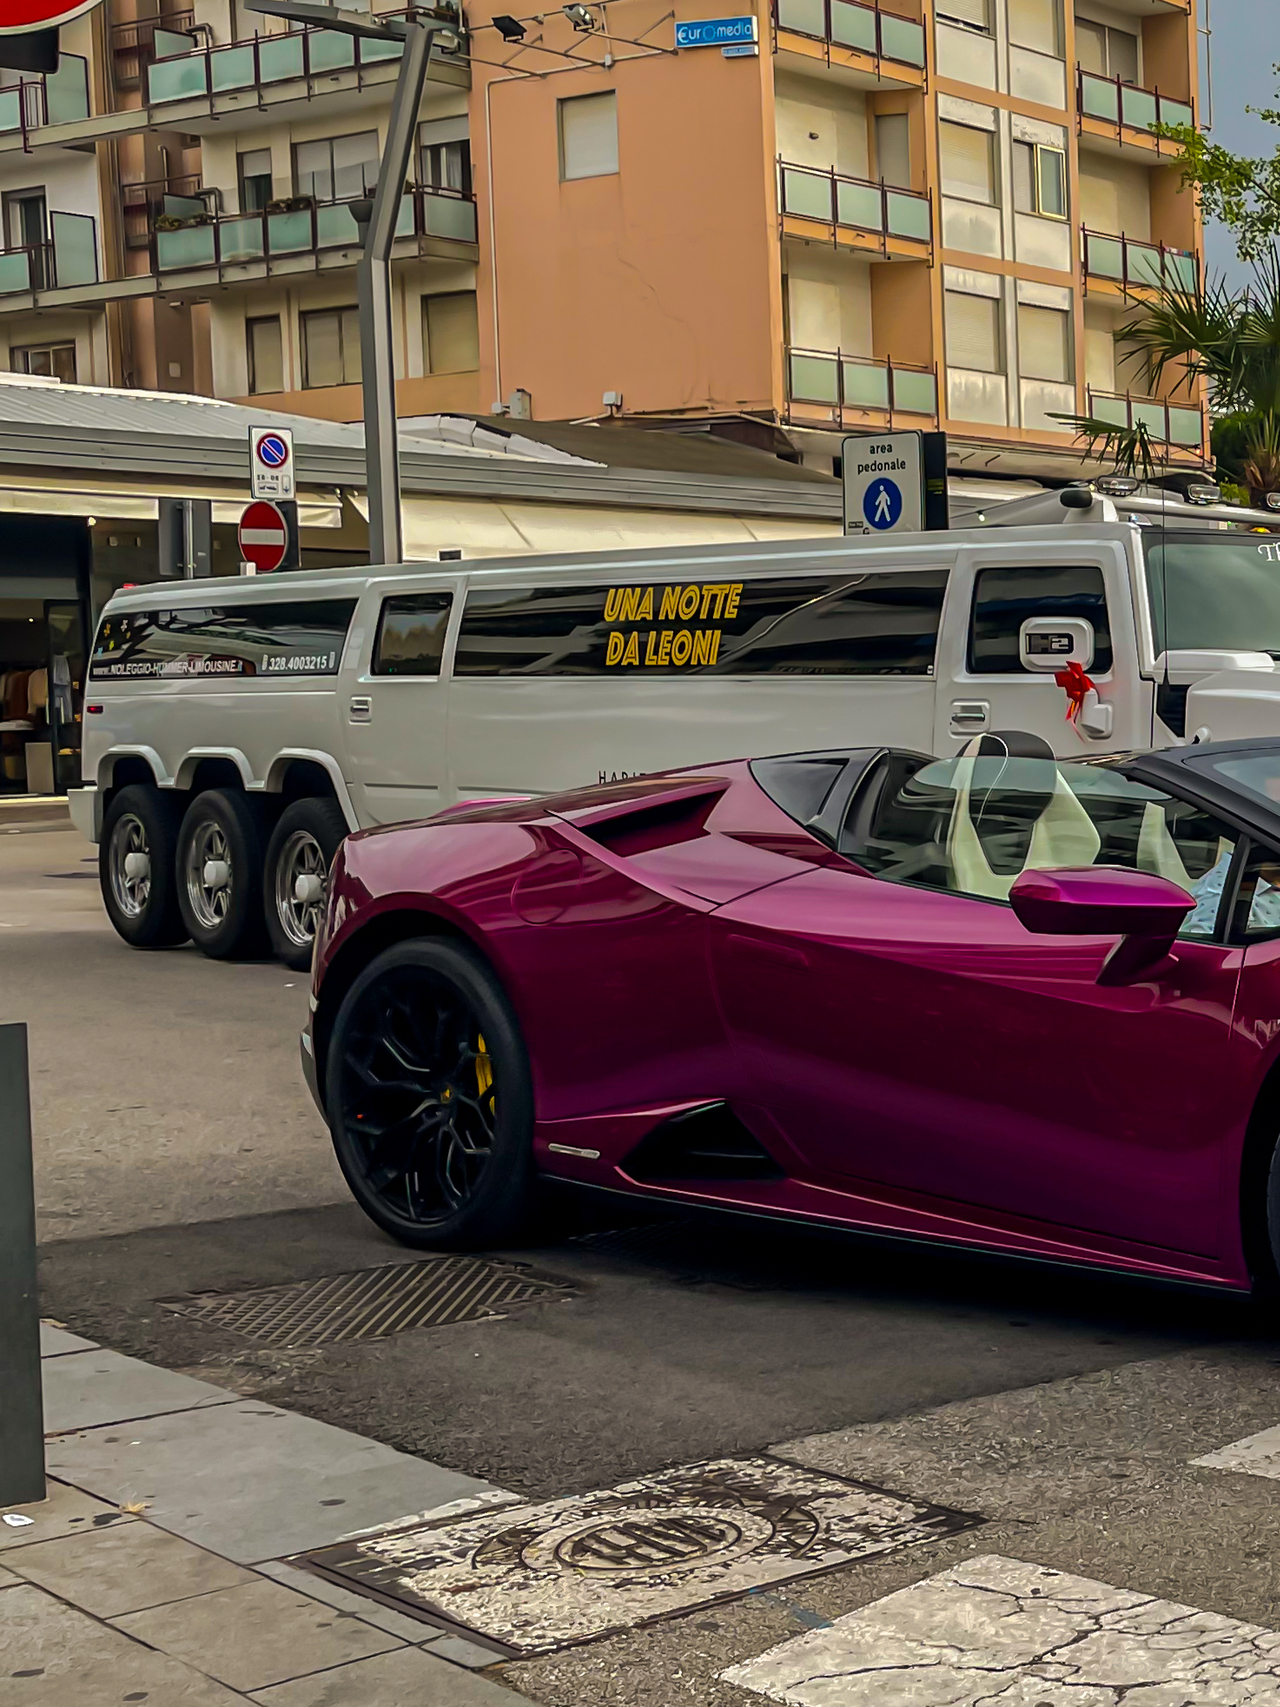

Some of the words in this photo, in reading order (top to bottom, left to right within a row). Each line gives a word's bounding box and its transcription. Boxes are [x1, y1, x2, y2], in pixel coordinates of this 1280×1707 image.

[869, 443, 893, 455] area
[857, 458, 906, 475] pedonale
[604, 587, 654, 621] UNA
[658, 583, 744, 621] NOTTE
[605, 631, 640, 666] DA
[644, 629, 722, 666] LEONI
